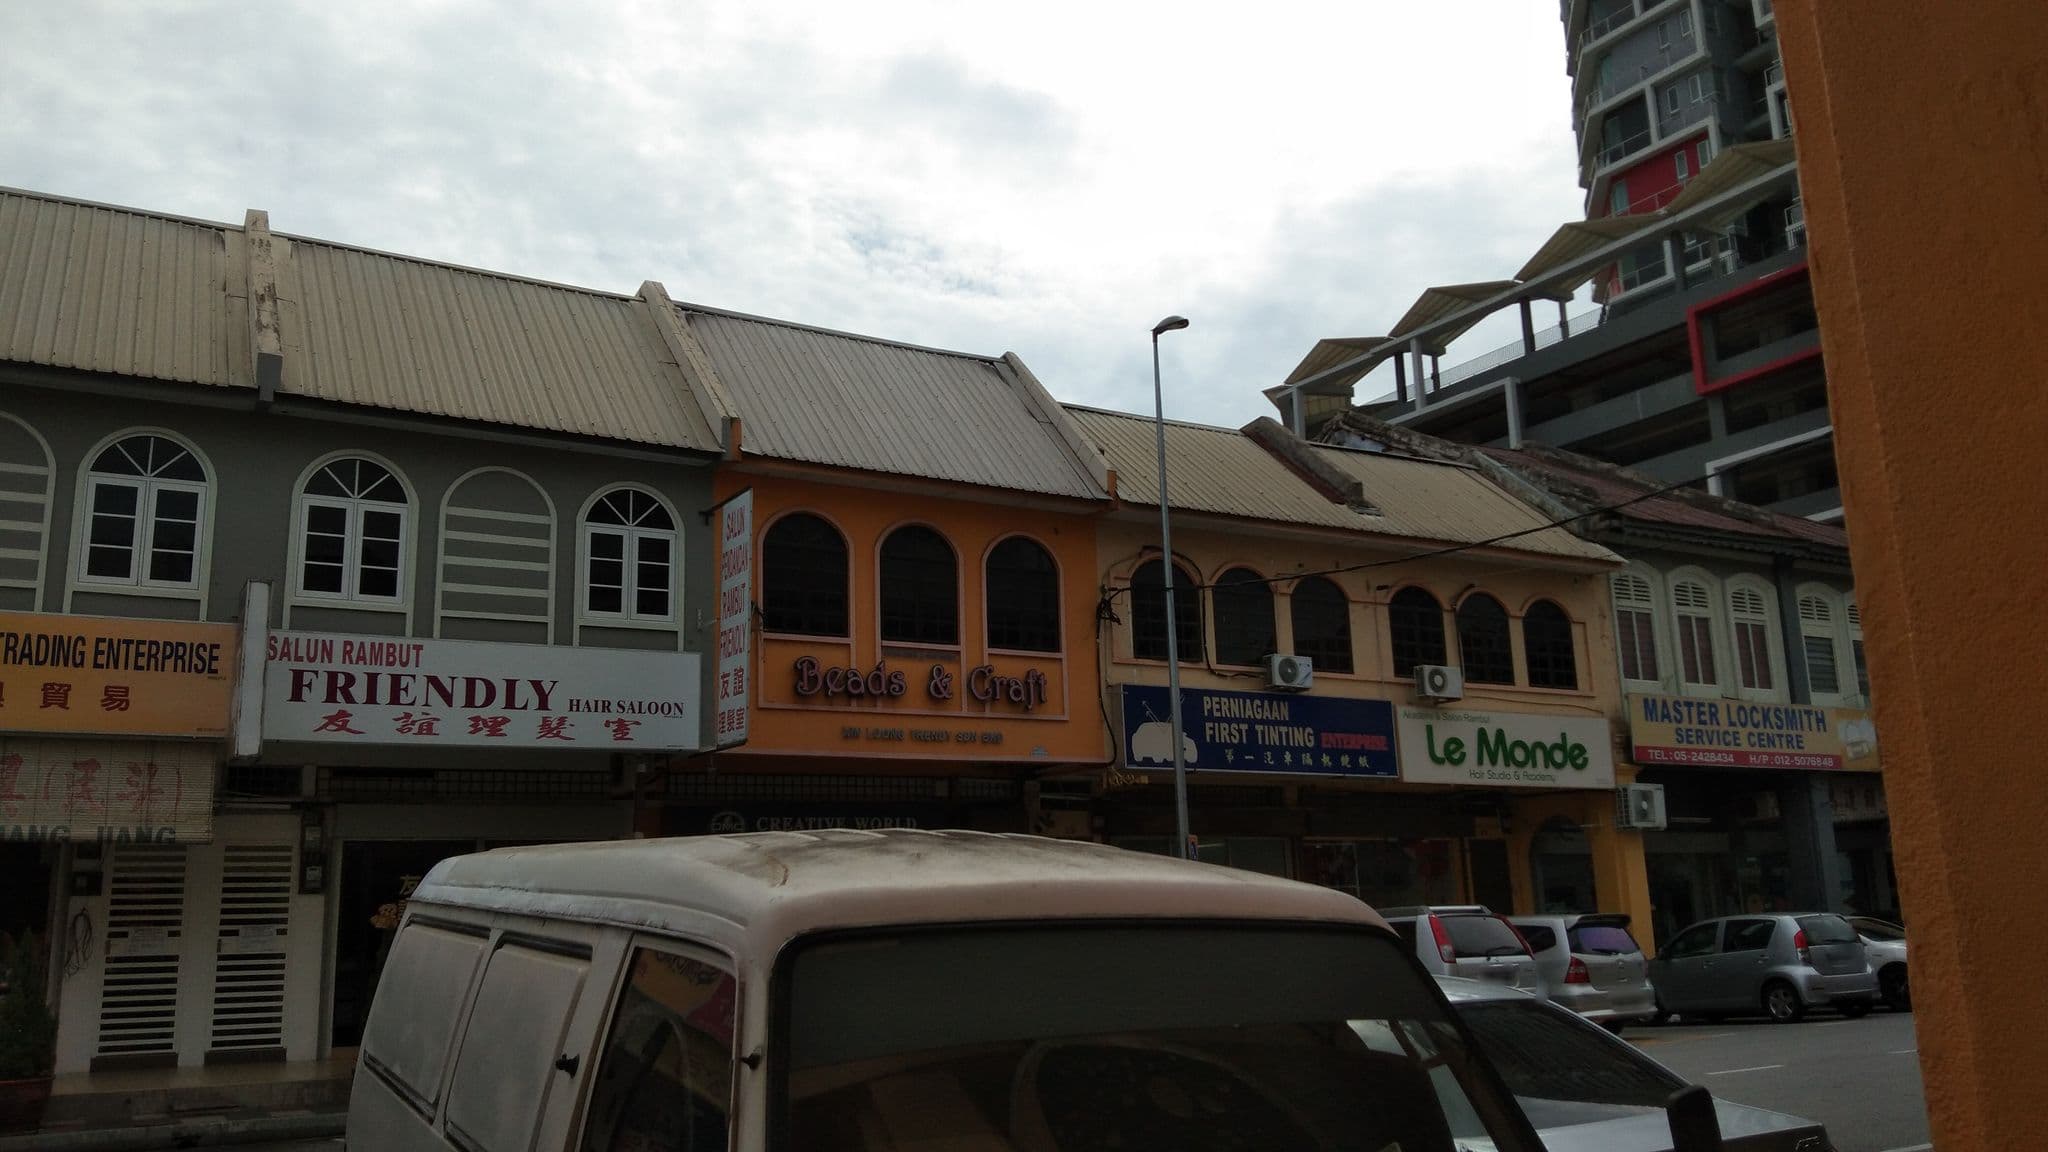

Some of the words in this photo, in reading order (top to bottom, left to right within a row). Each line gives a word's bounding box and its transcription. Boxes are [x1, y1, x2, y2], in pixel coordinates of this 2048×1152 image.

[93, 637, 220, 674] ENTERPRISE
[268, 636, 333, 664] SALUN
[342, 640, 424, 668] RAMBUT
[287, 668, 560, 712] FRIENDLY
[568, 698, 612, 714] HAIR
[615, 700, 684, 717] SALOON
[793, 655, 907, 698] Beads
[928, 663, 954, 701] &
[969, 664, 1048, 711] Craft
[1203, 696, 1289, 721] PERNIAGAAN
[1643, 698, 1720, 726] MASTER
[1727, 704, 1827, 732] LOCKSMITH
[1204, 721, 1249, 745] FIRST
[1255, 724, 1315, 747] TINTING
[1426, 724, 1466, 766] Le
[1477, 727, 1589, 770] Monde
[1675, 728, 1741, 747] SERVICE
[1747, 733, 1805, 750] CENTRE
